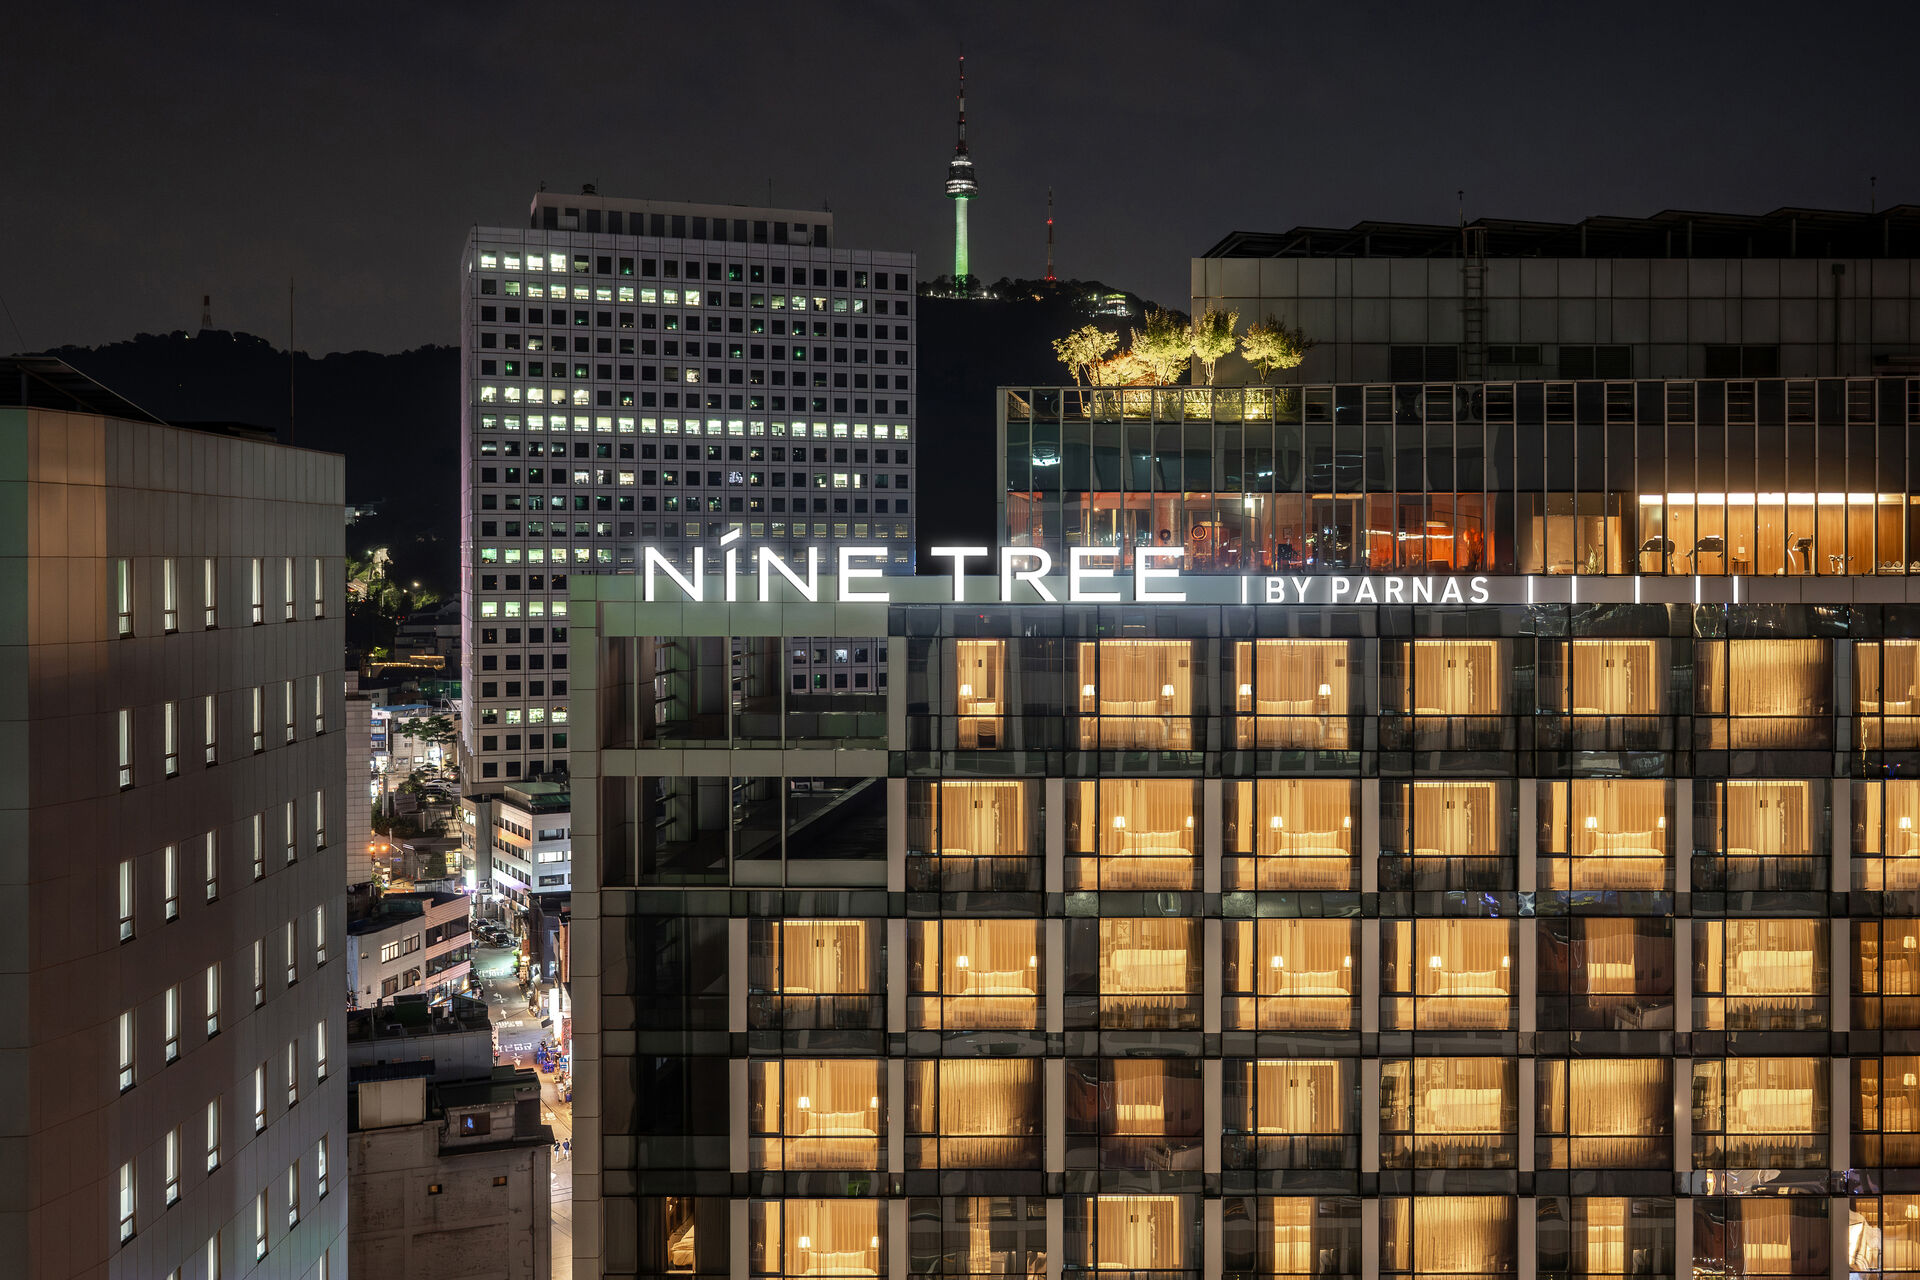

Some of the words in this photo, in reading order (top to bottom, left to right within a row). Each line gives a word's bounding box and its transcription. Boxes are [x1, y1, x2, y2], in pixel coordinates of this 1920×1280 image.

[930, 546, 1187, 602] TREE
[1266, 576, 1312, 603] BY
[1331, 576, 1489, 604] PARNAS
